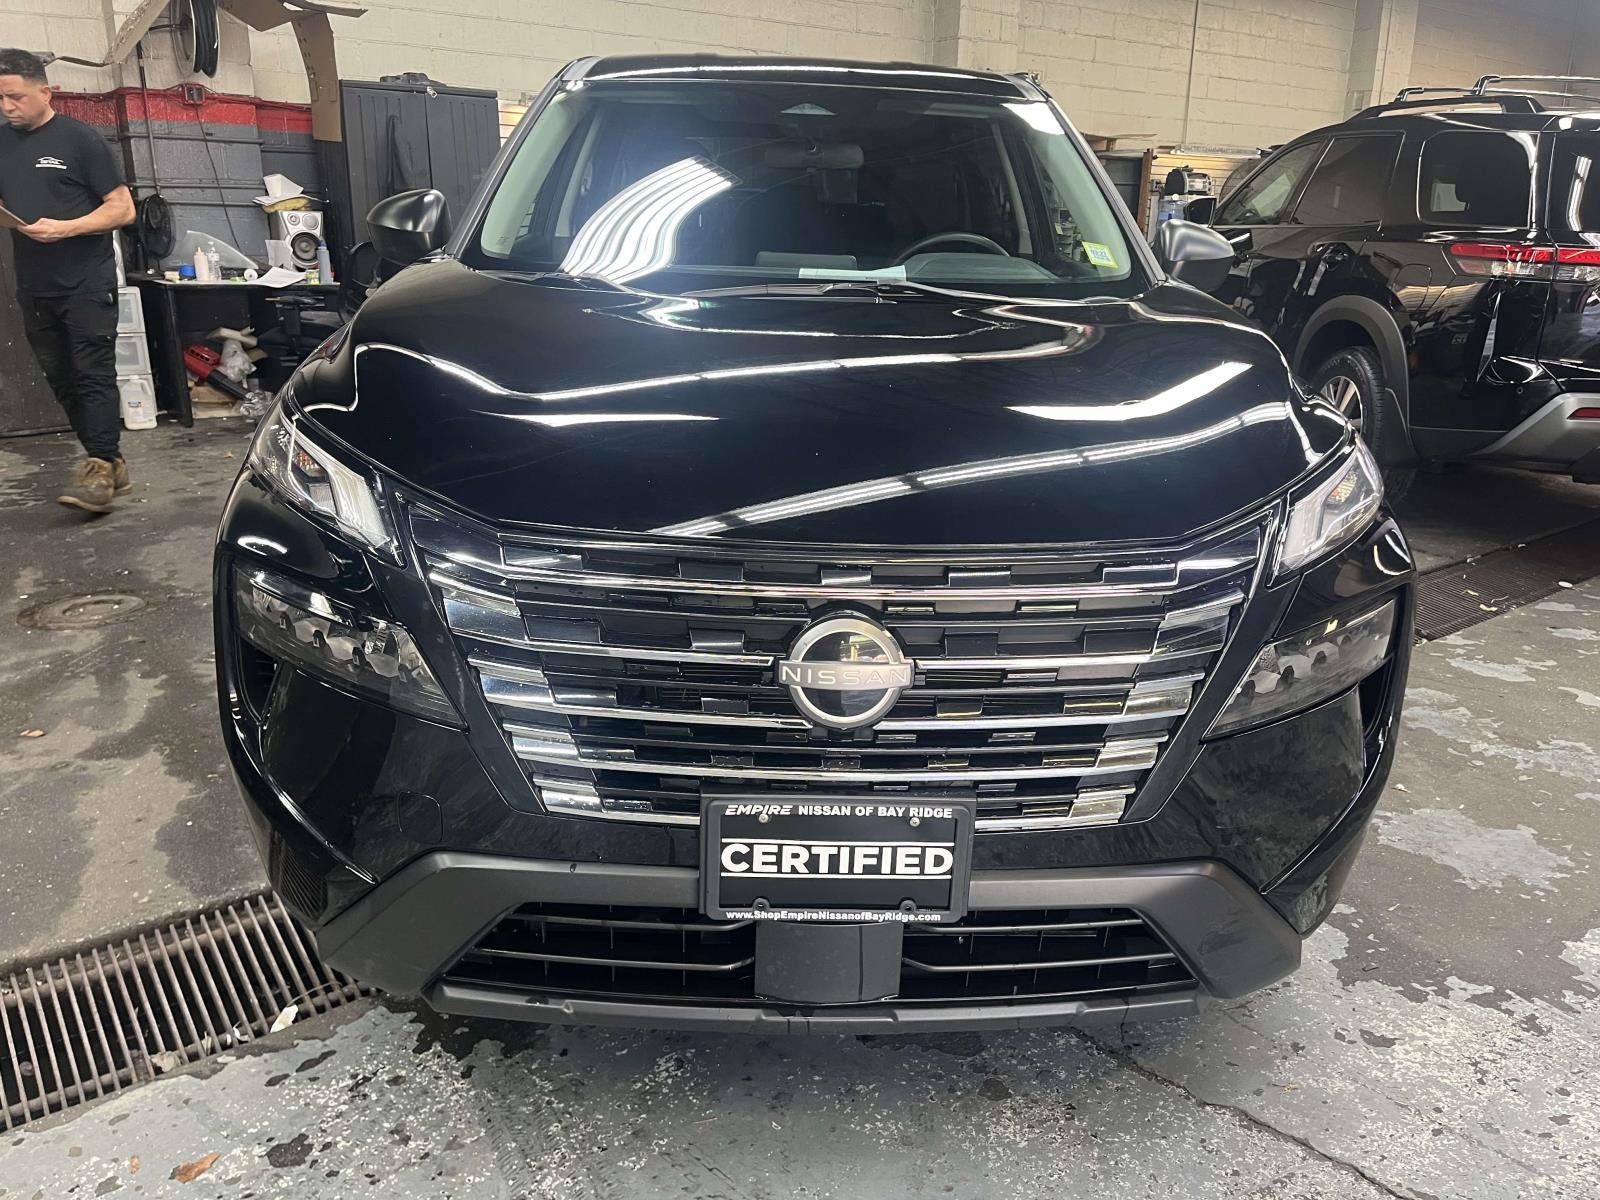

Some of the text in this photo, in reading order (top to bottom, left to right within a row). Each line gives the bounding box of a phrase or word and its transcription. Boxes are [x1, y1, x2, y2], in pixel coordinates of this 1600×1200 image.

[781, 667, 908, 685] NISSAN
[725, 804, 953, 819] EMPIRE NISSAN OF BAY RIDGE
[720, 843, 954, 875] CERTIFIED
[726, 910, 941, 922] www.ShopEmpireNissanofBayRidge.com
